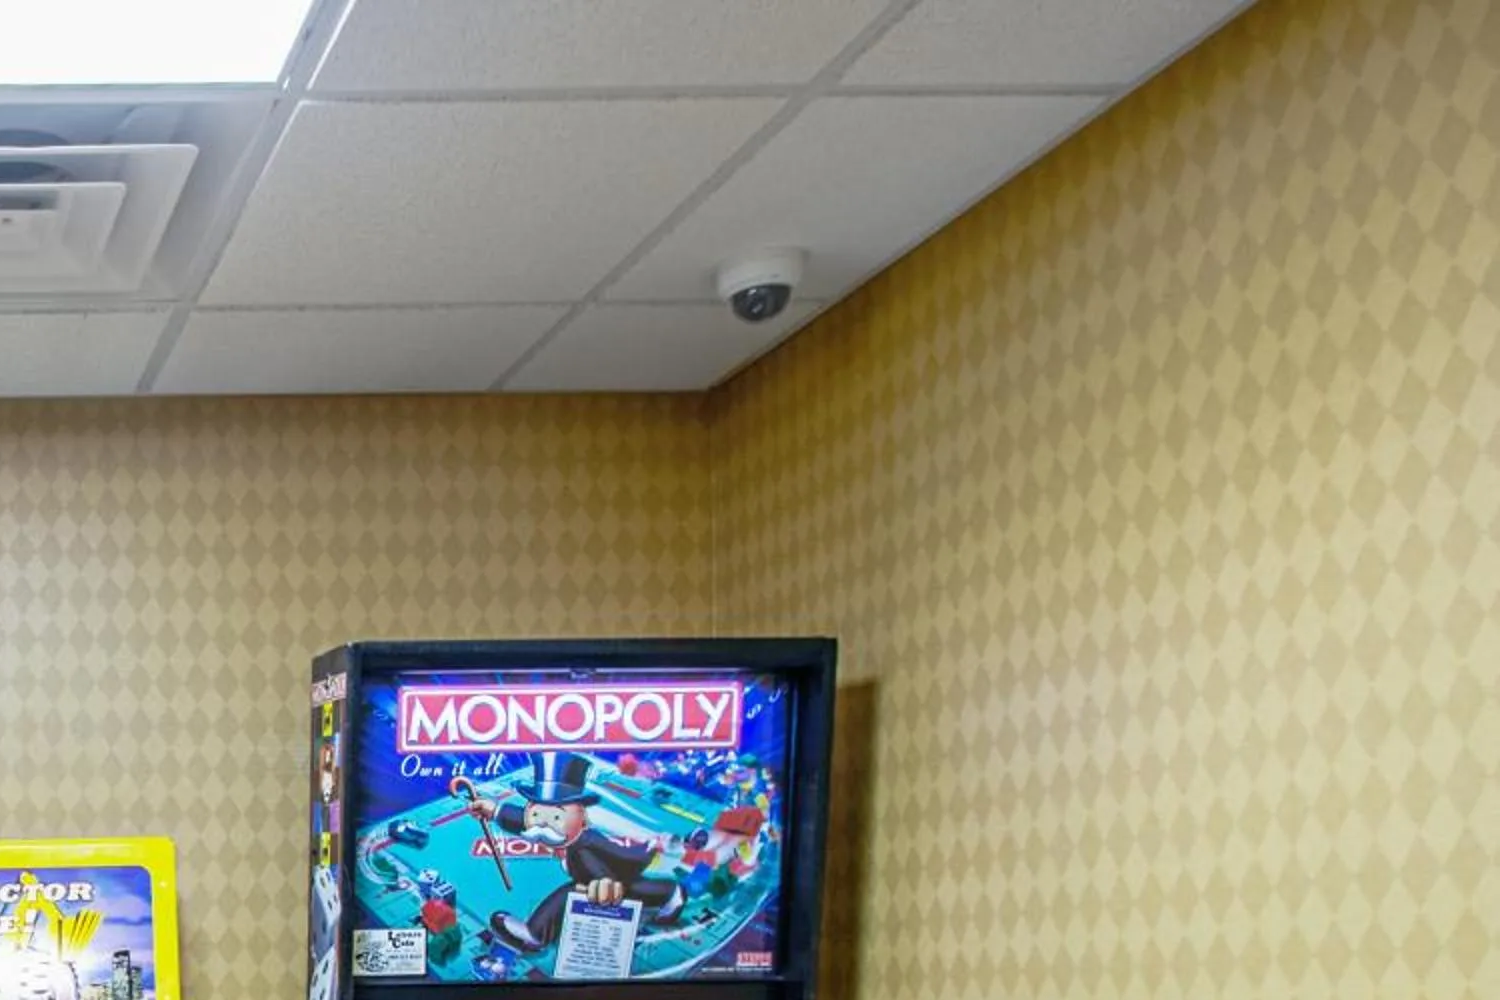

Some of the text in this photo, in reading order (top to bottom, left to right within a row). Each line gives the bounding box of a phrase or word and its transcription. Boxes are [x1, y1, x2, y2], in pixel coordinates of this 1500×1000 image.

[407, 692, 731, 743] MONOPOLY
[400, 752, 504, 778] Own it all
